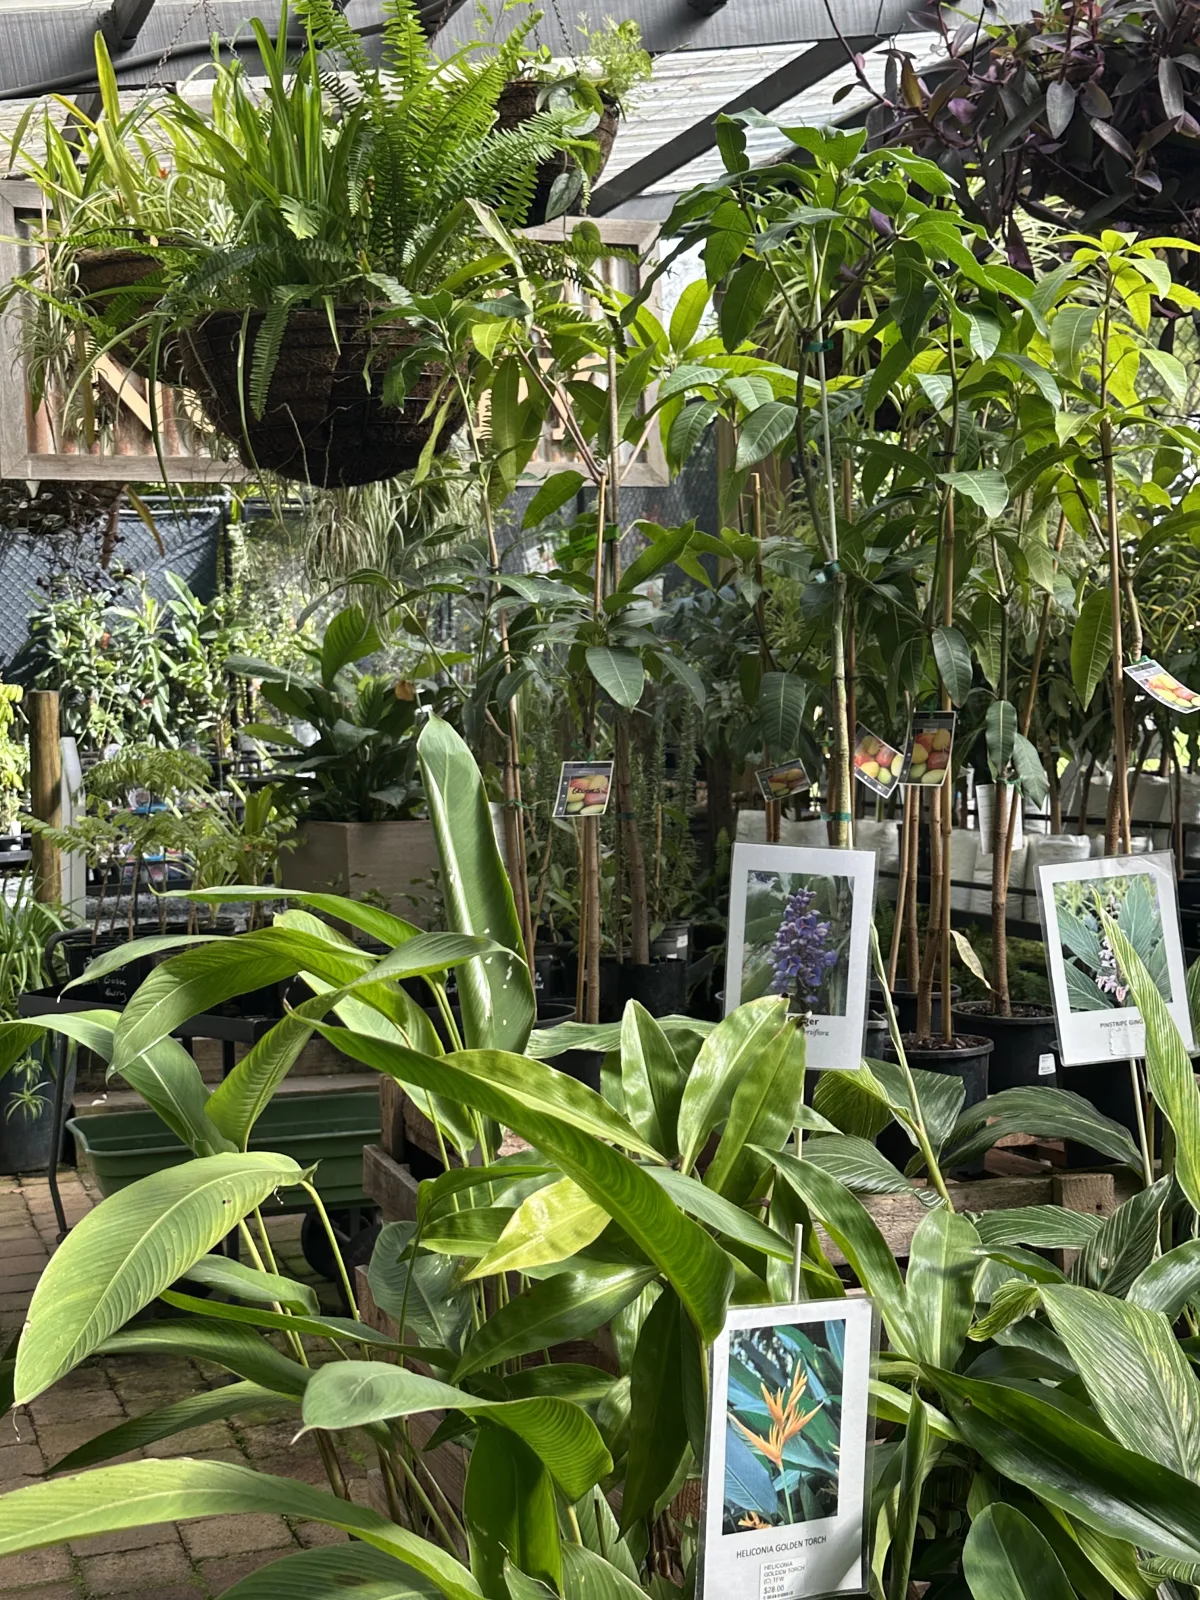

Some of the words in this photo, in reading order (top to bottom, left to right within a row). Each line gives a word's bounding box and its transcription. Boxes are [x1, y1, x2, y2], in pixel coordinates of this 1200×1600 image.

[1099, 1019, 1128, 1029] PINSTRIPE
[1128, 1018, 1144, 1026] GING
[736, 1545, 774, 1559] HELICONIA
[775, 1540, 803, 1553] GOLDEN
[805, 1535, 827, 1547] TORCH
[763, 1561, 793, 1571] HELICONIA
[763, 1584, 785, 1595] $28.00
